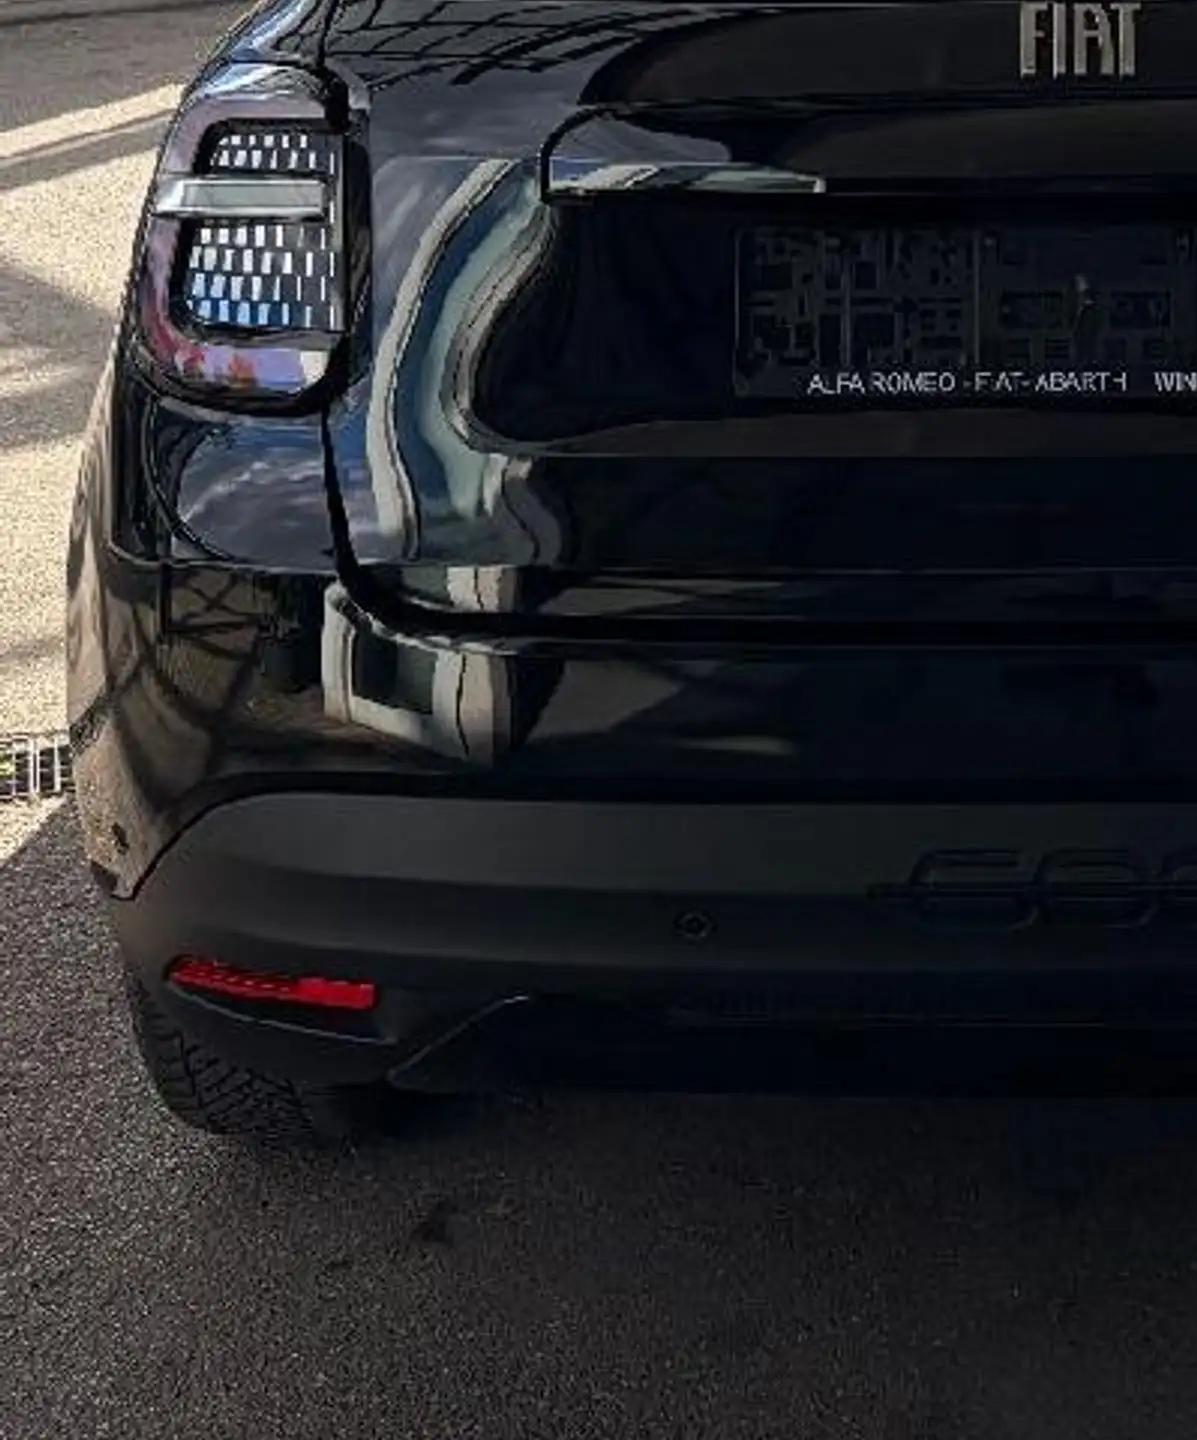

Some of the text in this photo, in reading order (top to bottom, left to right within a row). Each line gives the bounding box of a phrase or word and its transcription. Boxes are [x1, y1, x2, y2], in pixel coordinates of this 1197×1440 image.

[1019, 1, 1142, 80] FIAT
[807, 372, 866, 395] ALFA
[871, 371, 956, 394] ROMEO
[974, 371, 1025, 393] FAT
